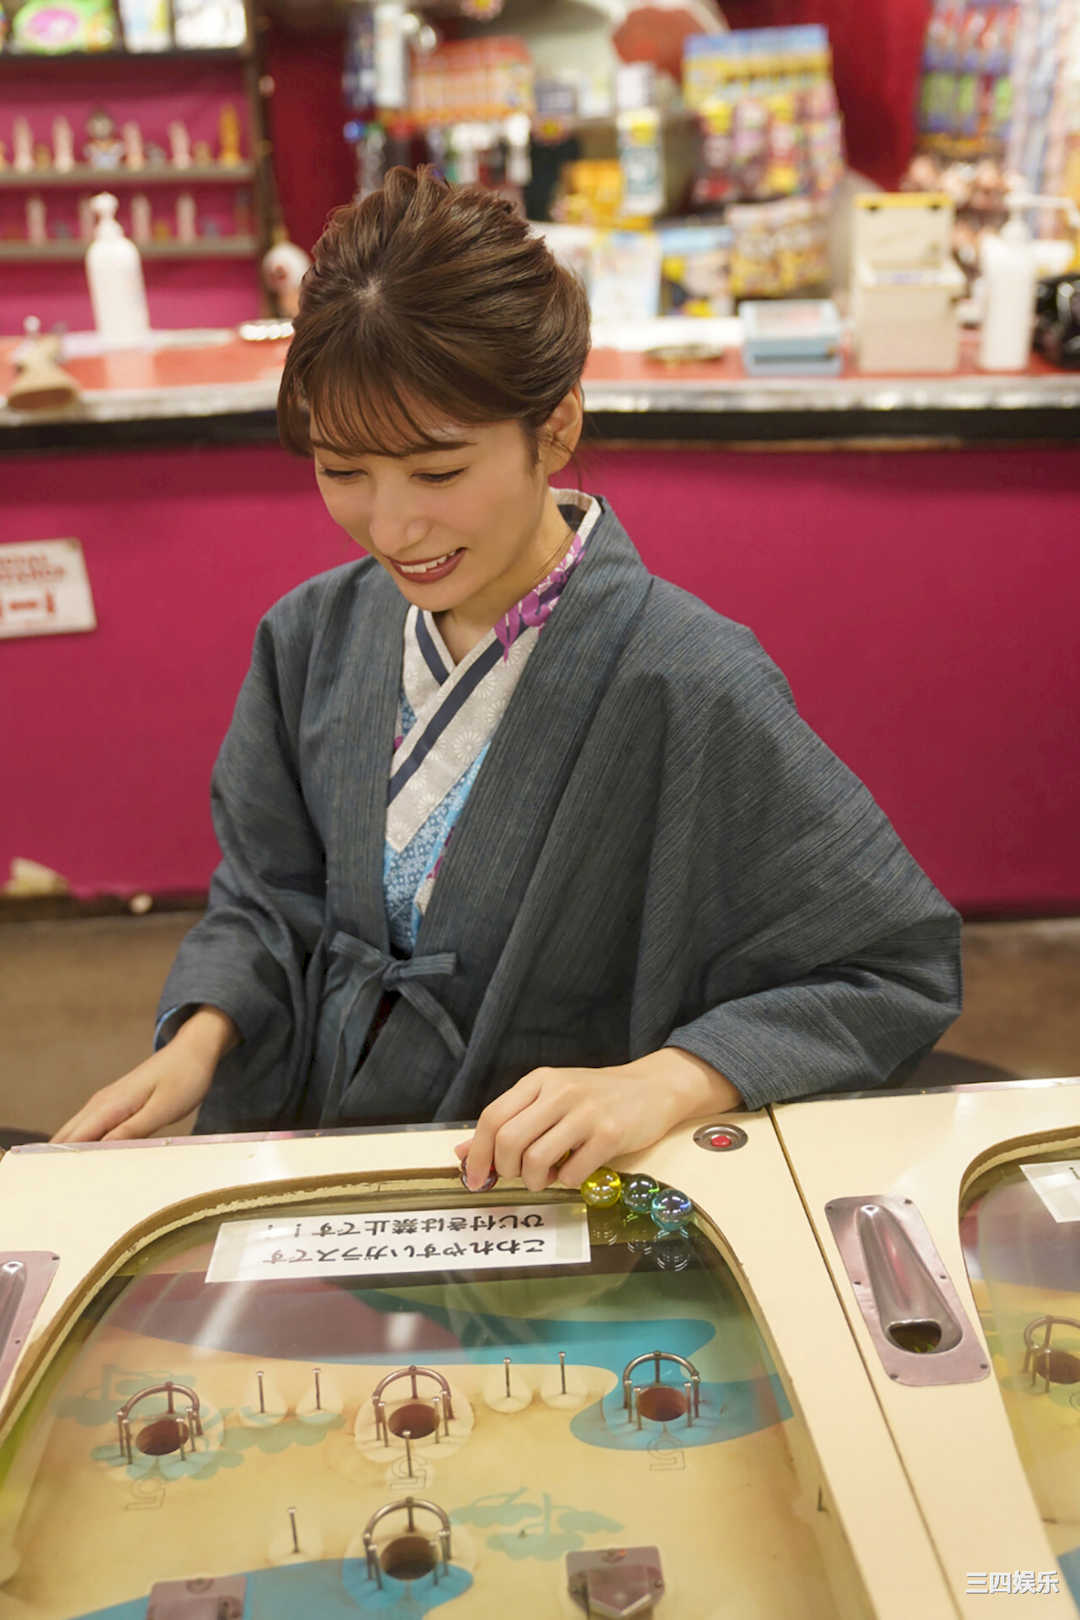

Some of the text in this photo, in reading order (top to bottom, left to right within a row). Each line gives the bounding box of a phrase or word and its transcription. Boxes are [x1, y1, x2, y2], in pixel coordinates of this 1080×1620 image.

[262, 1239, 545, 1264] こわれやすいガラスです
[388, 1455, 428, 1490] 5
